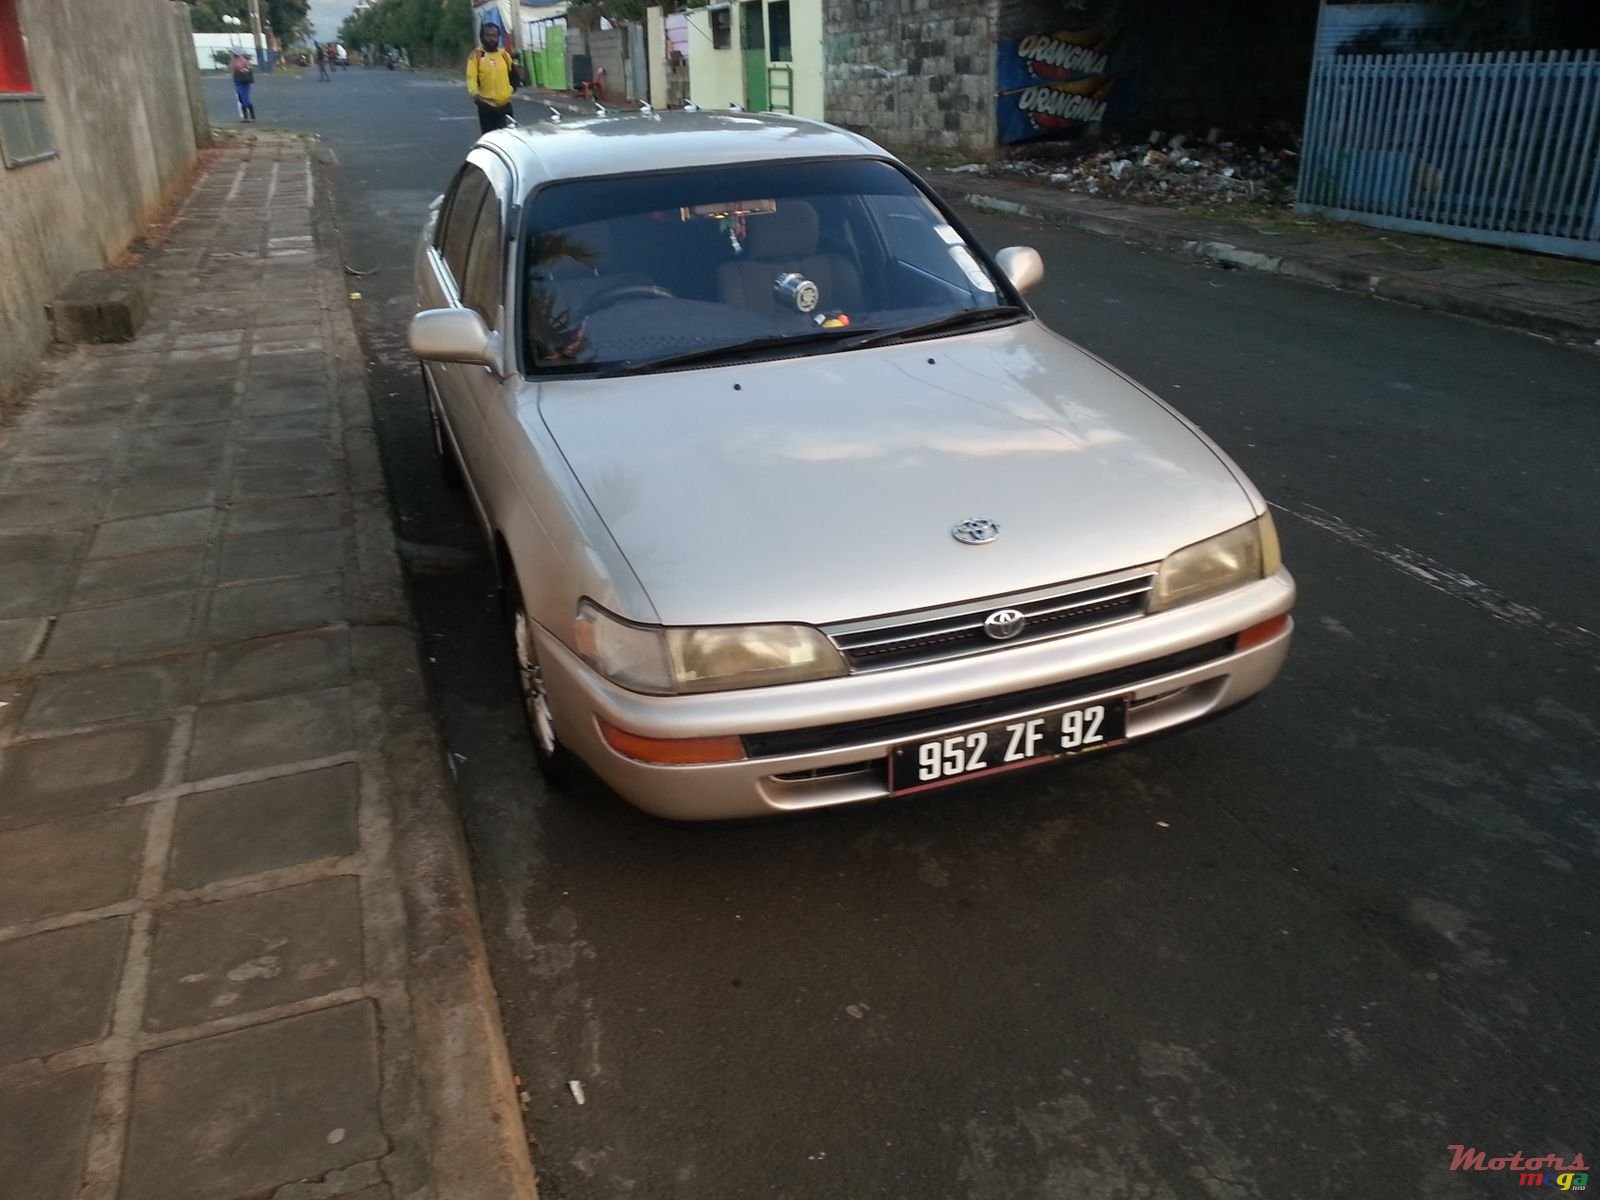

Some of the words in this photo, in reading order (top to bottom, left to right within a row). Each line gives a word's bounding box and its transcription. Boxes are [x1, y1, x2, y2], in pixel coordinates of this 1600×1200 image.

[1018, 35, 1108, 73] ORANGINA
[1018, 87, 1108, 122] ORANGINA
[918, 732, 988, 781] 952
[1003, 719, 1045, 762] ZF
[1060, 705, 1105, 749] 92
